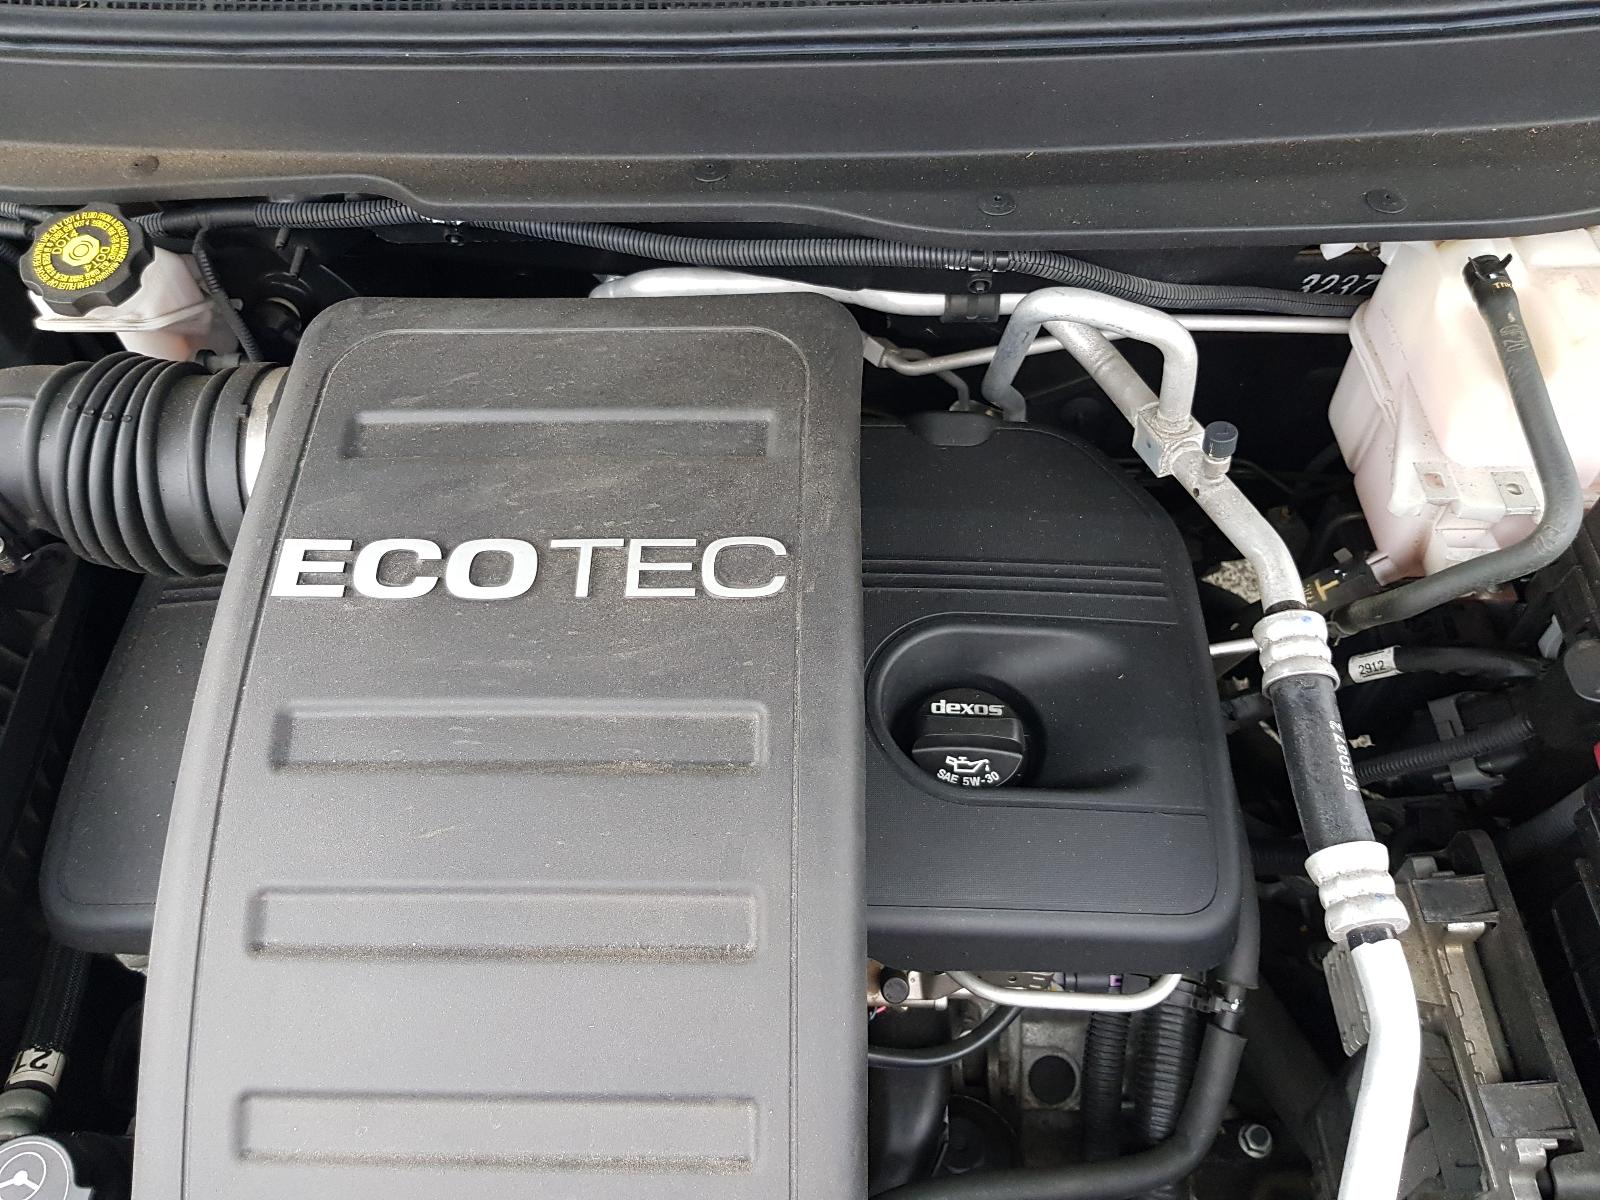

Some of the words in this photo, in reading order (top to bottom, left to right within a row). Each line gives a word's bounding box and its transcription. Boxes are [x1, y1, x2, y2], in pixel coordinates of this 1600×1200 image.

[49, 221, 64, 234] ONLY
[63, 215, 76, 225] DOT
[270, 536, 790, 601] ECOTEC
[1358, 660, 1386, 675] 2912
[931, 699, 1005, 716] dexos
[936, 768, 960, 784] SAE
[962, 771, 1000, 787] 5W-30
